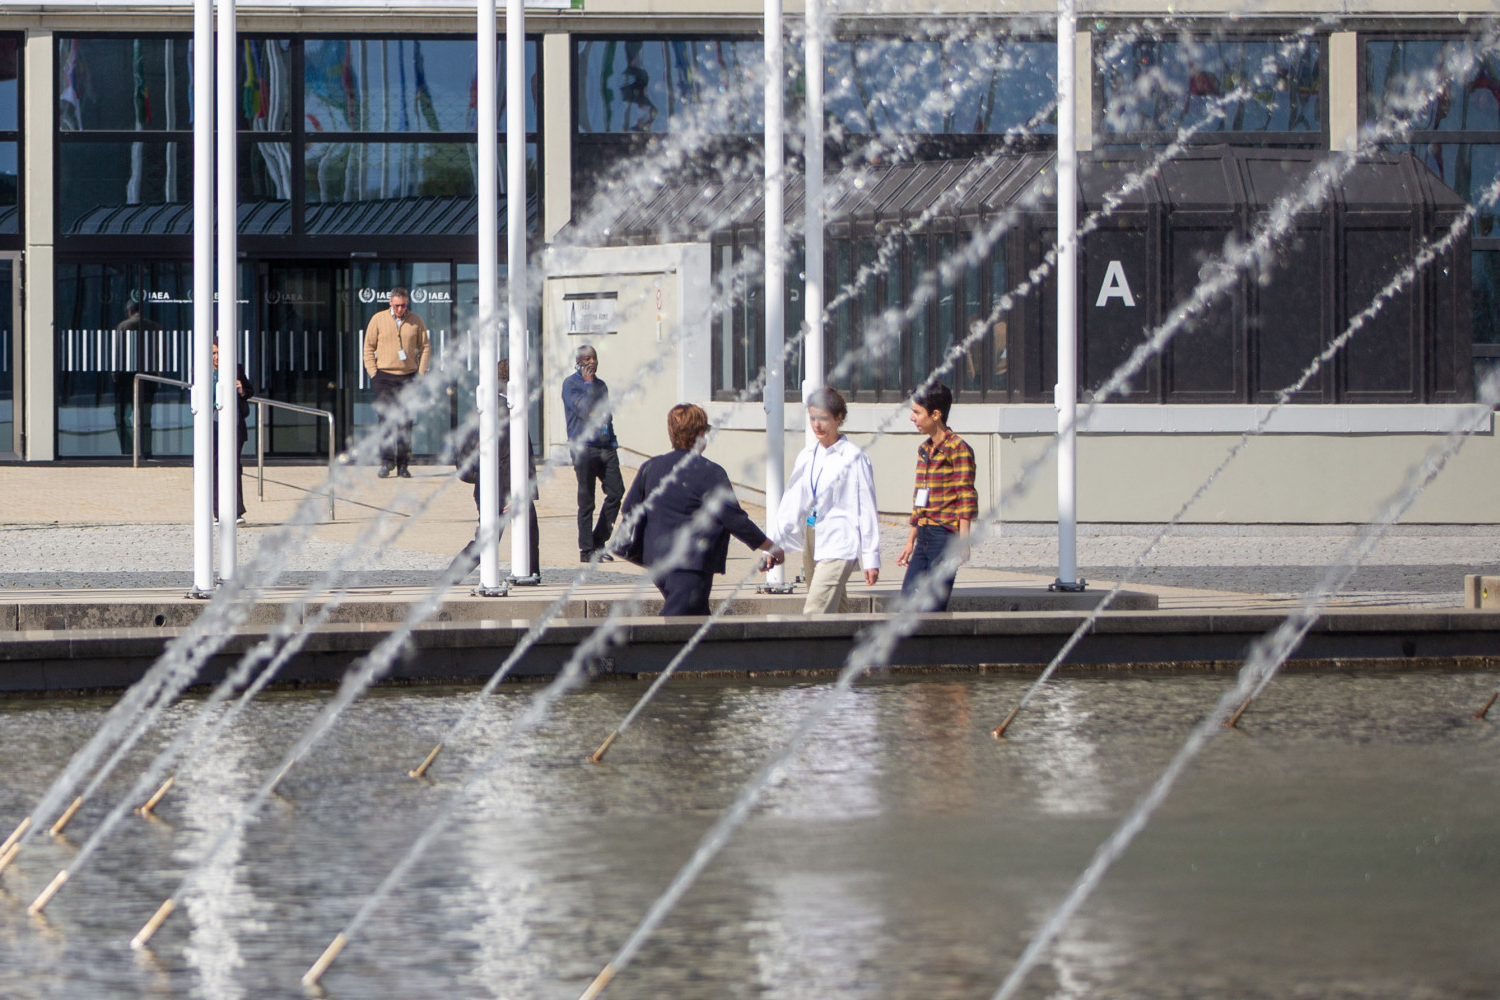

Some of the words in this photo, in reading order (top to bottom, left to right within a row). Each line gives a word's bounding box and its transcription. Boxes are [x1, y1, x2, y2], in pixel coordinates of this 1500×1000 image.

[1095, 260, 1136, 307] A
[148, 291, 170, 300] IAEA
[376, 291, 392, 300] IAE
[428, 291, 450, 300] IAEA
